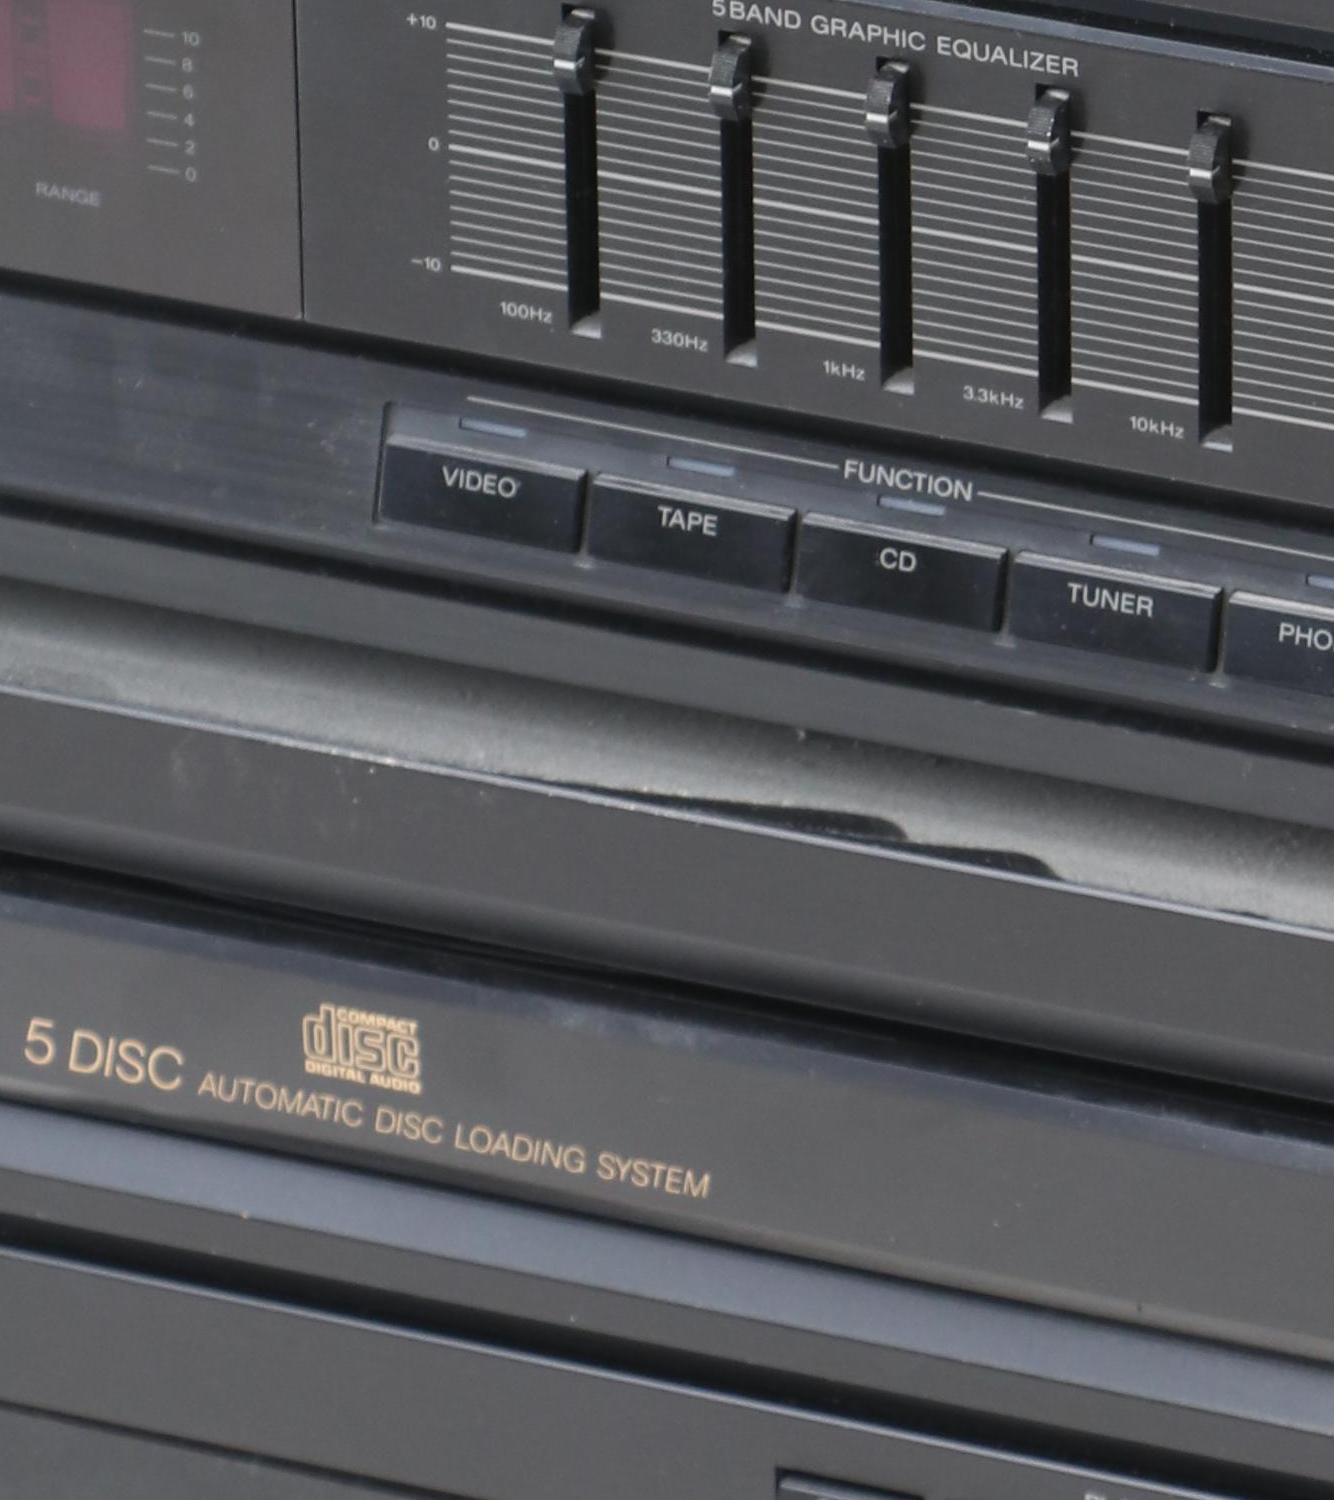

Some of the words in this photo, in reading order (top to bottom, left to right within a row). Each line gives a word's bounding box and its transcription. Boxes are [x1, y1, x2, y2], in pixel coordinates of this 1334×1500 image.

[406, 13, 436, 30] +10
[811, 14, 925, 52] GRAPHIC
[937, 36, 1079, 78] EQUALIZER
[36, 182, 100, 207] RANGE
[499, 301, 553, 324] 100Hz
[651, 329, 708, 351] 330Hz
[822, 360, 865, 381] 1kHz
[963, 385, 1024, 410] 3.3kHz
[1129, 416, 1185, 440] 10kHz
[442, 465, 517, 498] VIDEO
[844, 460, 973, 501] FUNCTION
[658, 504, 718, 536] TAPE
[879, 548, 917, 573] CD
[1068, 582, 1154, 617] TUNER
[337, 1008, 418, 1034] COMPACT
[305, 1059, 366, 1084] DIGITAL
[369, 1072, 422, 1096] AUDIO
[24, 1019, 55, 1065] 5
[68, 1031, 183, 1091] DISC
[198, 1072, 363, 1128] AUTOMATIC
[376, 1106, 443, 1144] DISC
[455, 1124, 585, 1174] LOADING
[597, 1153, 710, 1199] SYSTEM
